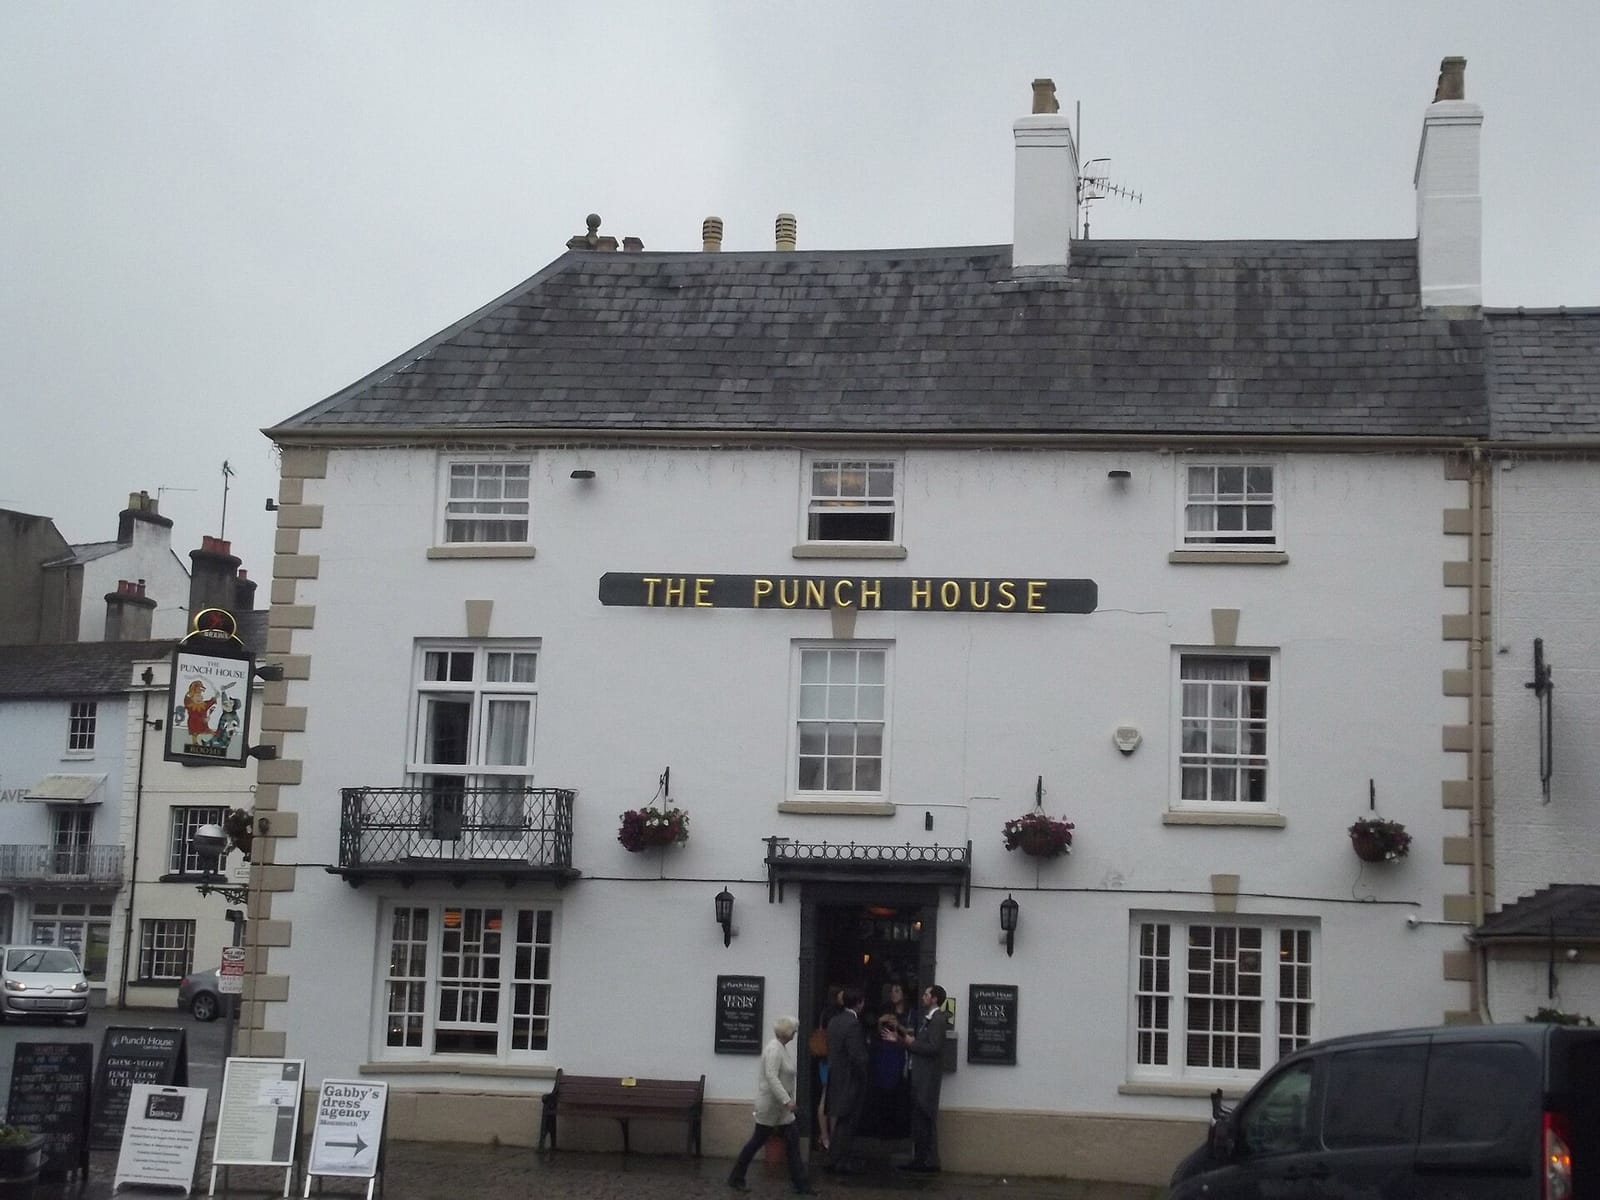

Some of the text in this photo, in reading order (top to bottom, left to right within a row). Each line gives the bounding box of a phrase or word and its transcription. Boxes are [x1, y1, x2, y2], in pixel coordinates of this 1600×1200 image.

[642, 577, 1048, 612] THE PUNCH HOUSE
[180, 663, 246, 679] PUNCH HOUSE
[120, 1035, 175, 1047] Punch House
[324, 1085, 380, 1101] Gabby's
[322, 1097, 361, 1109] dress
[321, 1107, 370, 1120] agency
